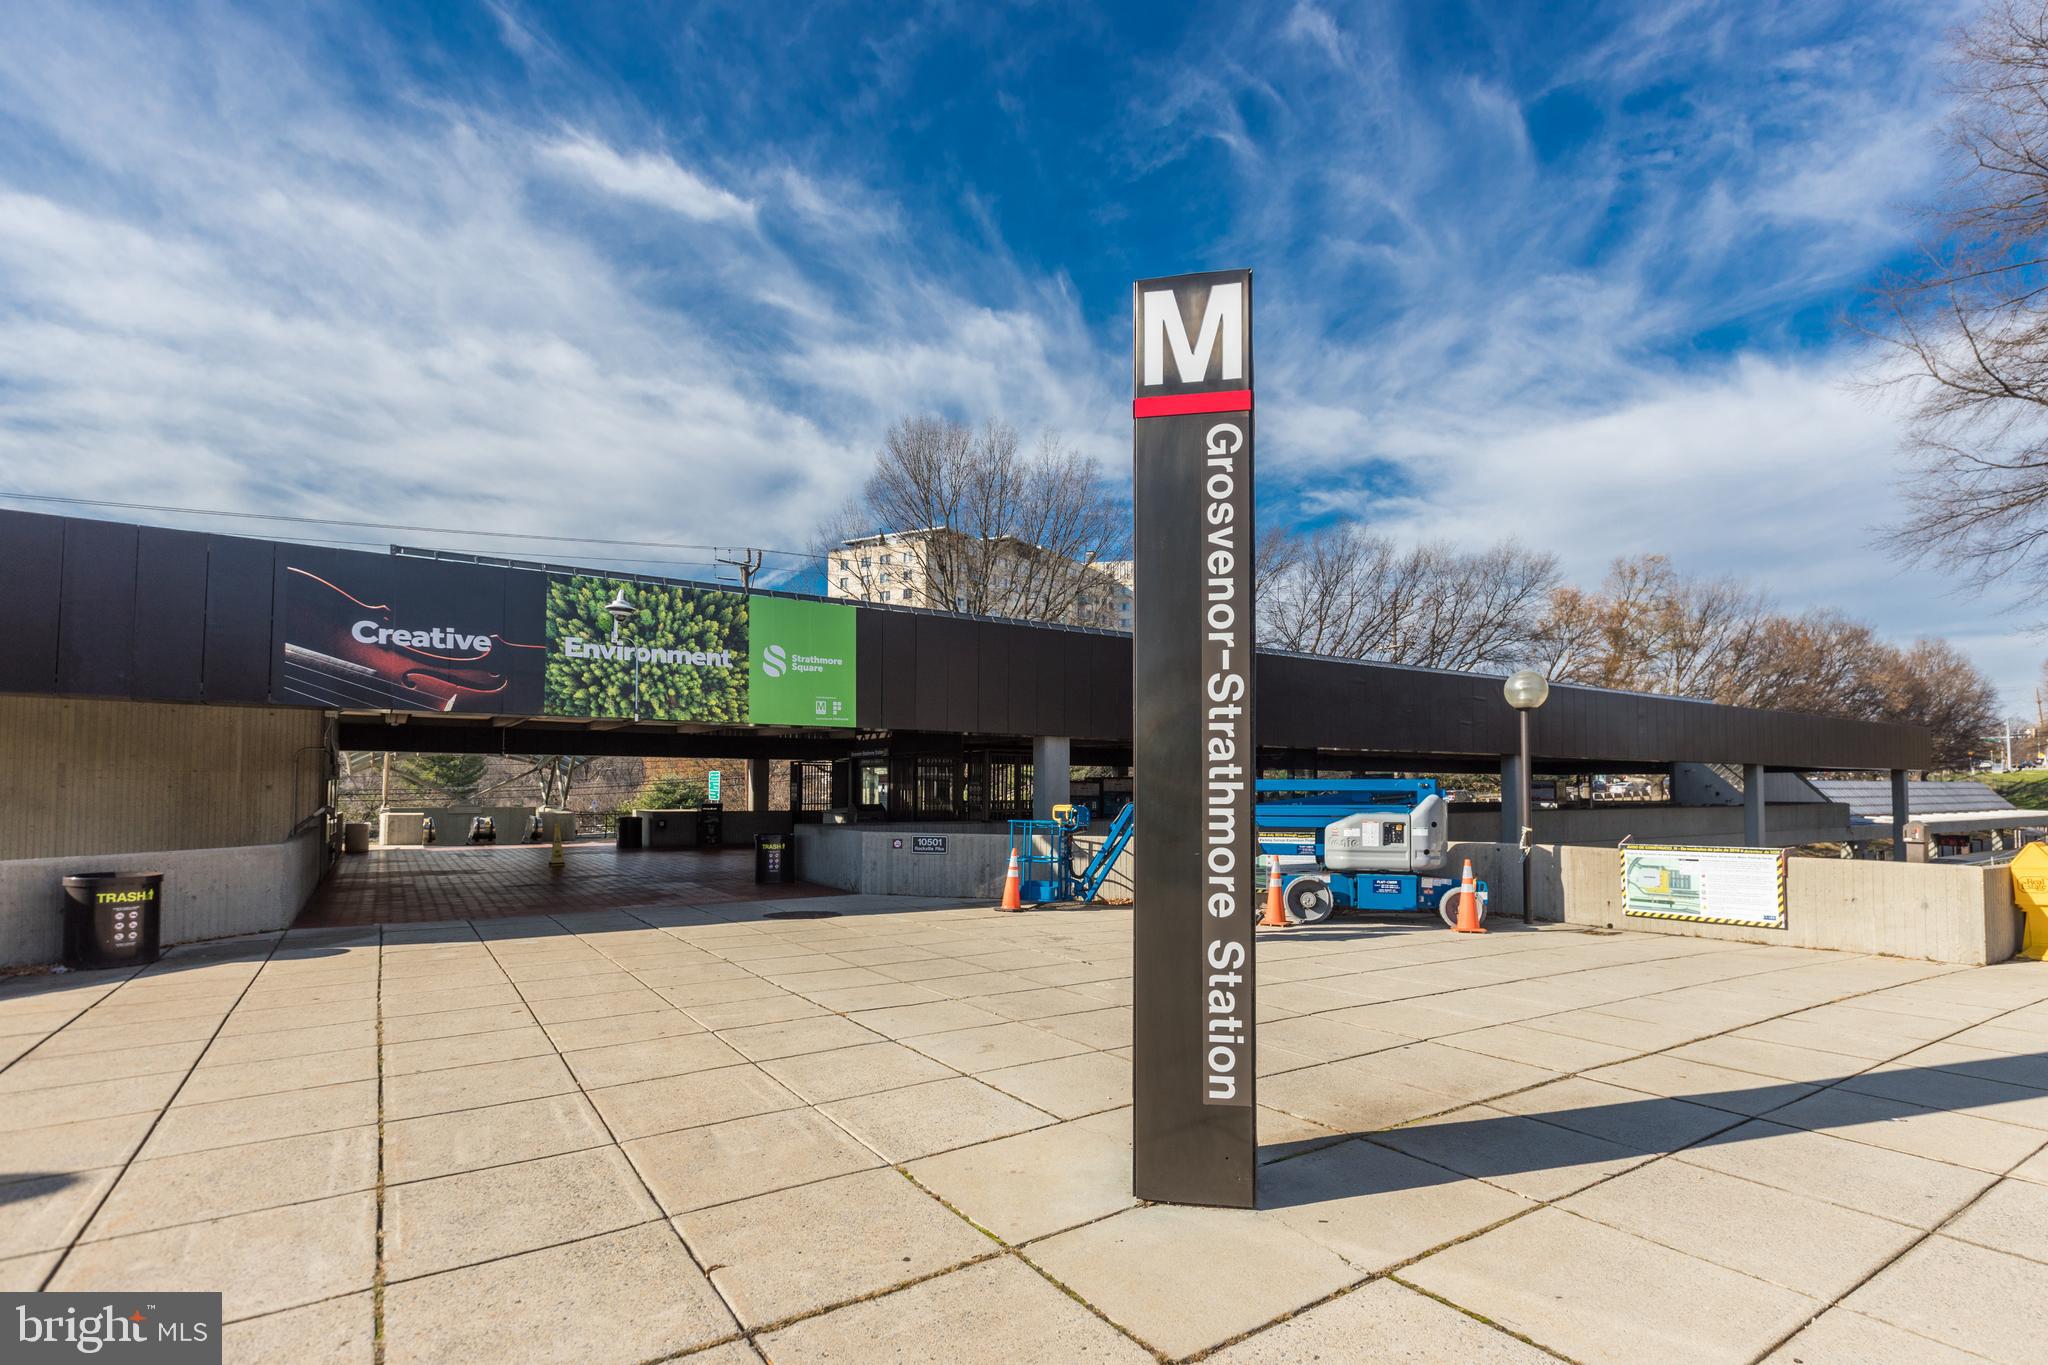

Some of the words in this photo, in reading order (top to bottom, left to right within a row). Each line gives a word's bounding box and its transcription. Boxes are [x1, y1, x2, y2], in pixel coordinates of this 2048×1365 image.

[1143, 282, 1243, 387] M
[351, 620, 492, 652] Creative
[564, 636, 733, 668] Environment
[791, 654, 842, 666] Strathmore
[791, 663, 824, 672] Square
[1207, 423, 1245, 919] Grosvenor-Strathmore
[918, 838, 943, 847] 10501
[96, 891, 146, 904] TRASH
[1207, 939, 1246, 1100] Station
